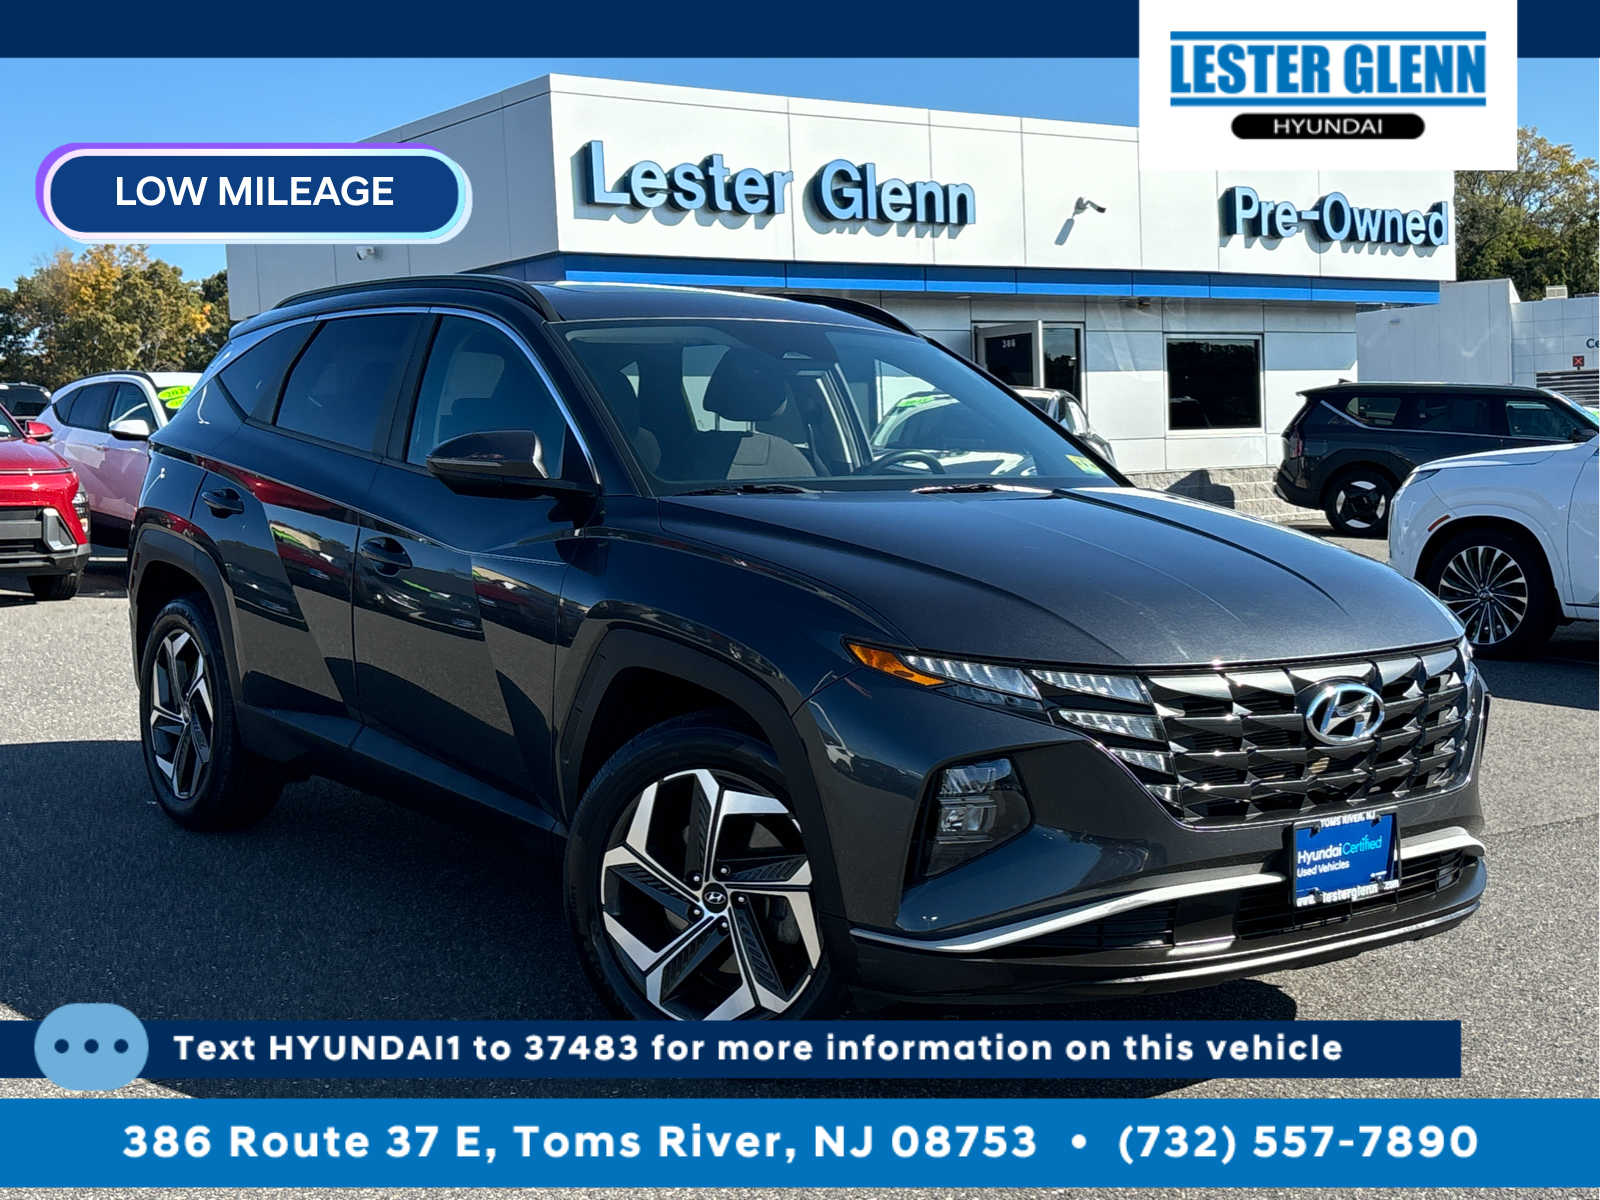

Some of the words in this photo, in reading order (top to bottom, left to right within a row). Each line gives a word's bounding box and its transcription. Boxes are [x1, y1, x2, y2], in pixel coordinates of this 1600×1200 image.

[584, 140, 793, 216] Lester
[815, 158, 976, 225] Glenn
[1226, 185, 1449, 246] Pre-Owned
[1296, 865, 1318, 878] Used
[1318, 860, 1350, 875] Vehicles
